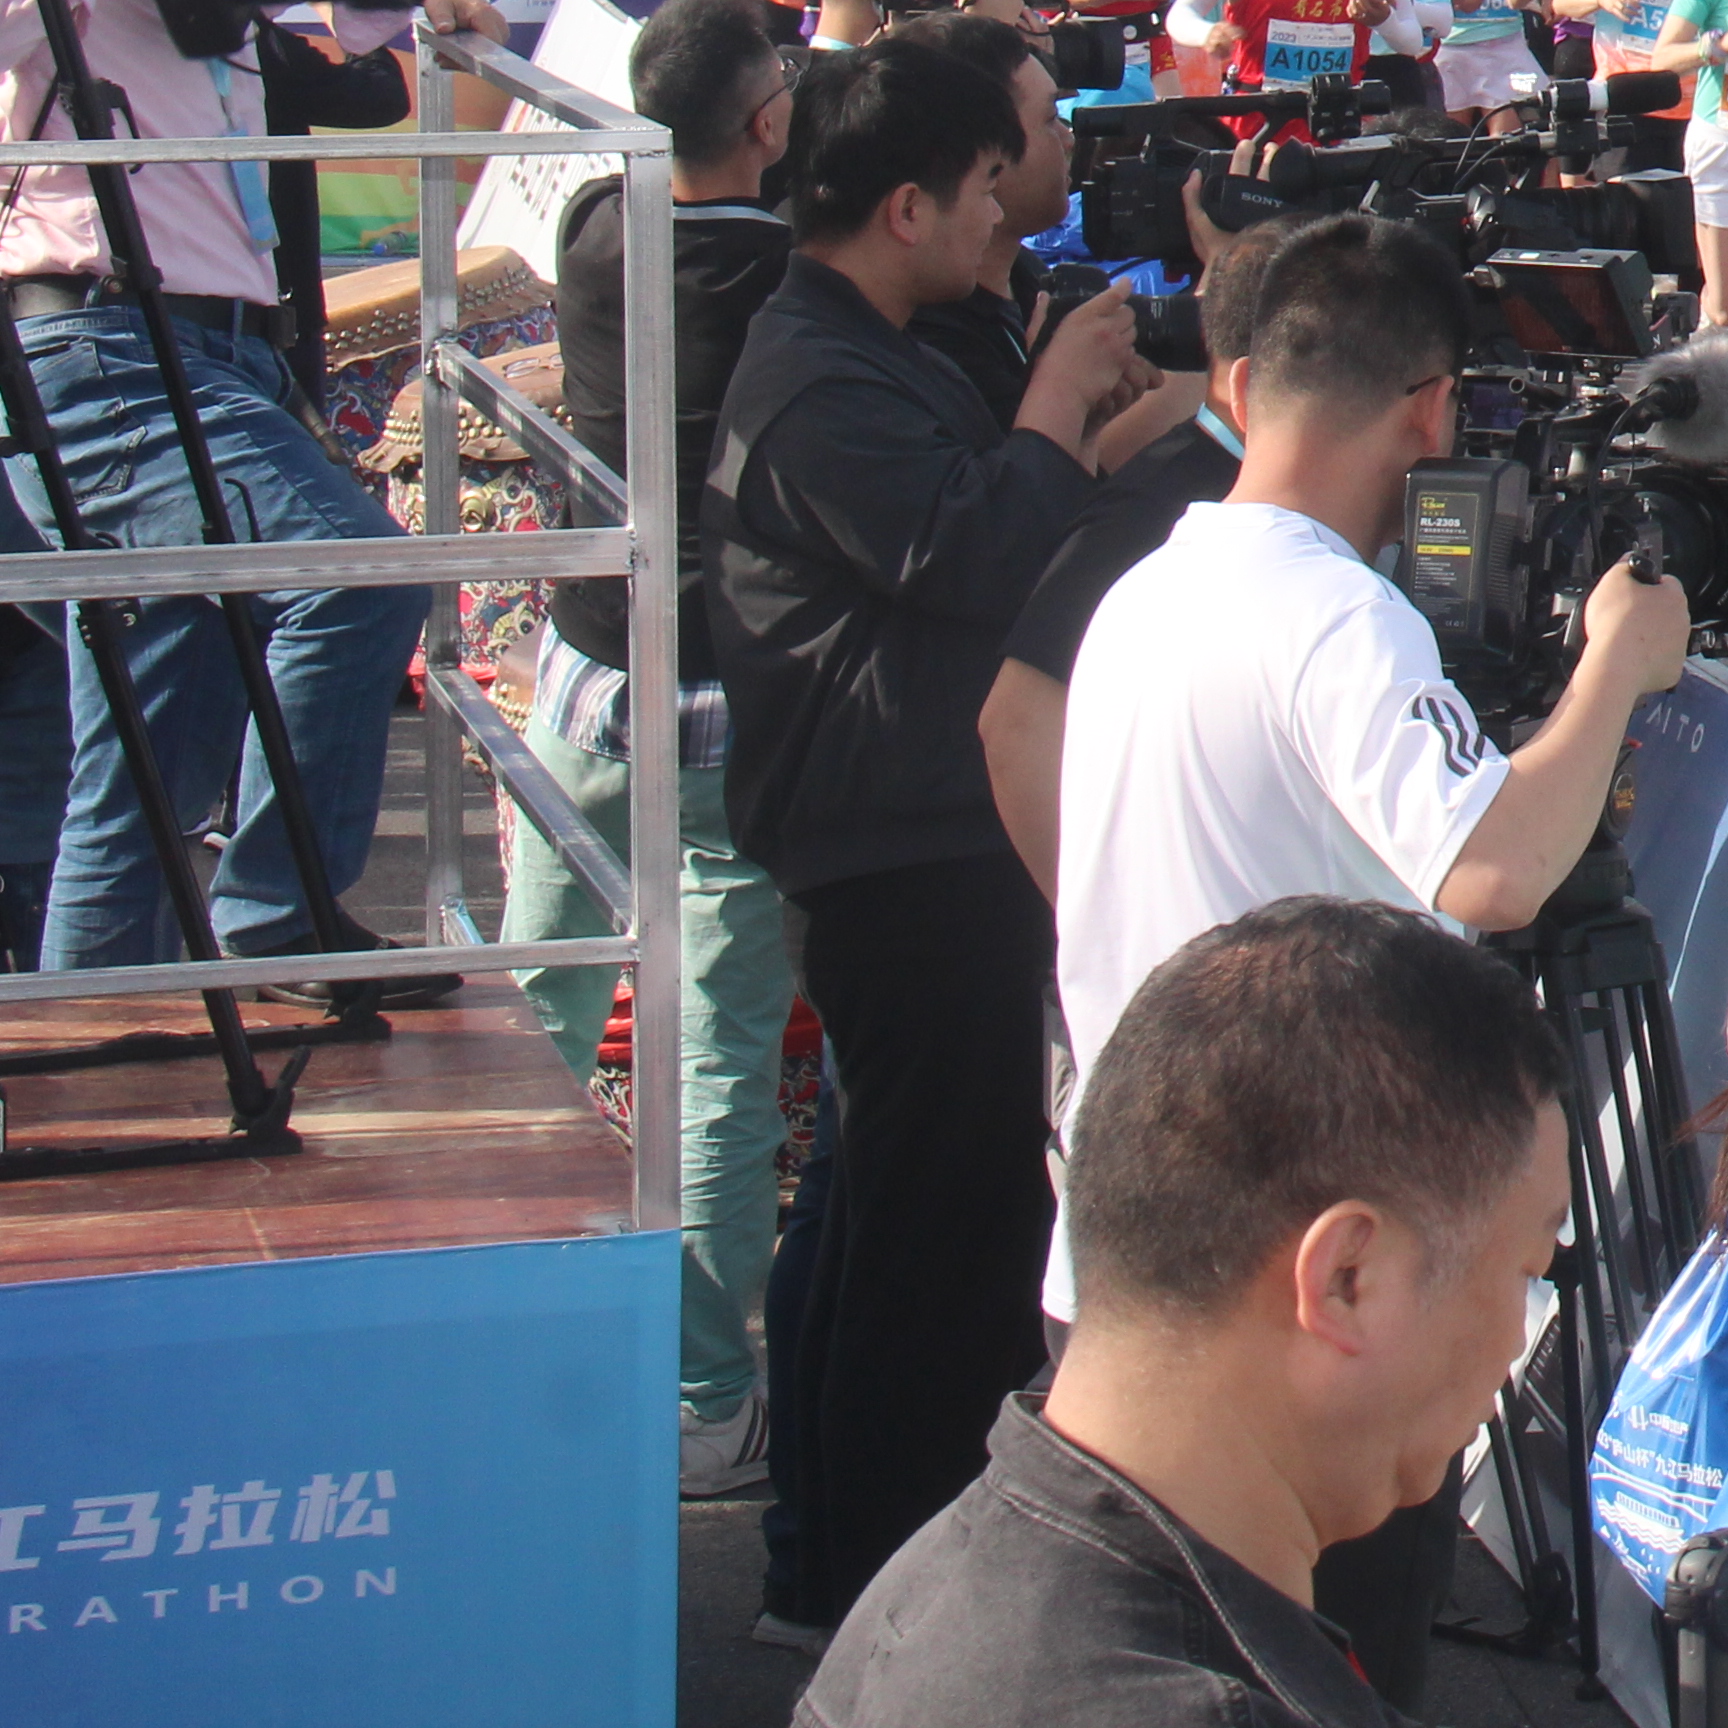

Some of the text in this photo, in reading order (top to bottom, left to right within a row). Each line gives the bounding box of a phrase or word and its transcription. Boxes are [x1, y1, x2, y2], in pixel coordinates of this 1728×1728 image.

[1271, 30, 1298, 43] 2023
[1270, 48, 1348, 74] A1054
[1240, 189, 1286, 210] SONY
